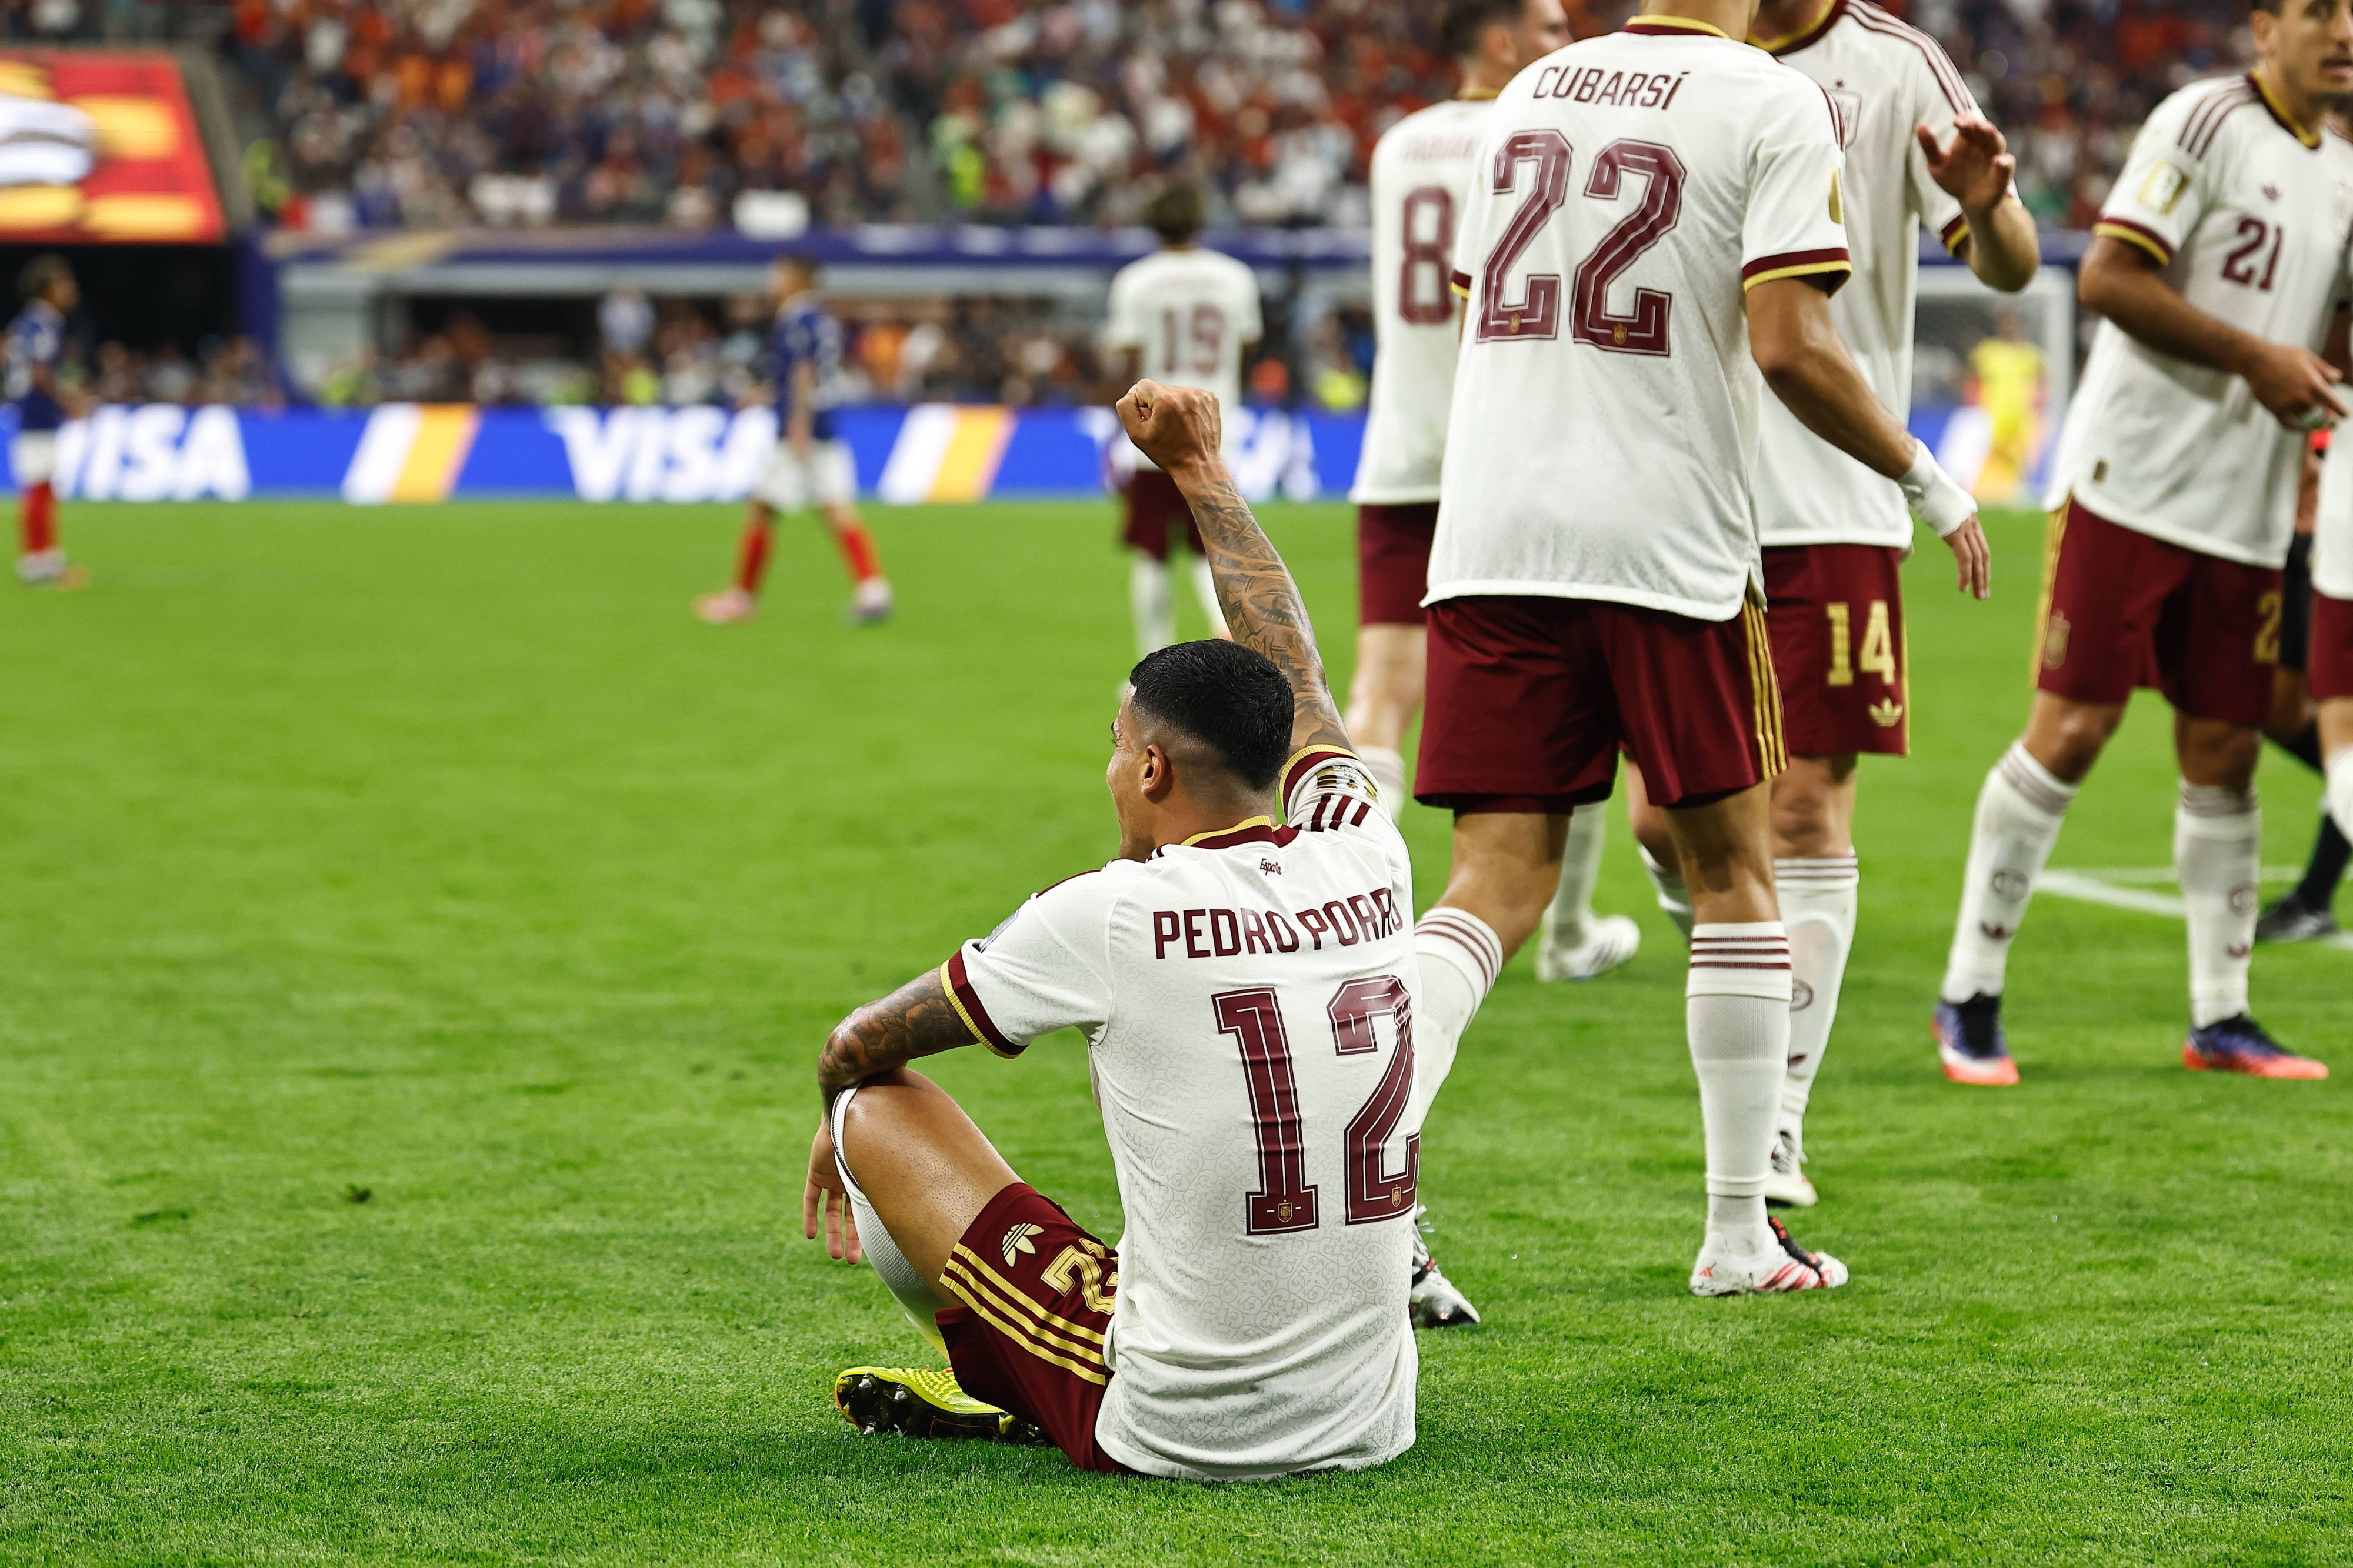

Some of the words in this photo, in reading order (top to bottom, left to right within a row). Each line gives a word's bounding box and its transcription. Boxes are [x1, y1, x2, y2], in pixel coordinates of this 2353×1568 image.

[1533, 66, 1690, 110] CUBARSÍ
[1398, 187, 1455, 325] 8
[1477, 129, 1687, 357] 22
[2222, 218, 2284, 292] 21
[1161, 303, 1225, 376] 19
[1827, 600, 1895, 686] 14
[1259, 858, 1282, 876] España
[1153, 908, 1299, 959] PEDRO
[1211, 974, 1420, 1235] 12
